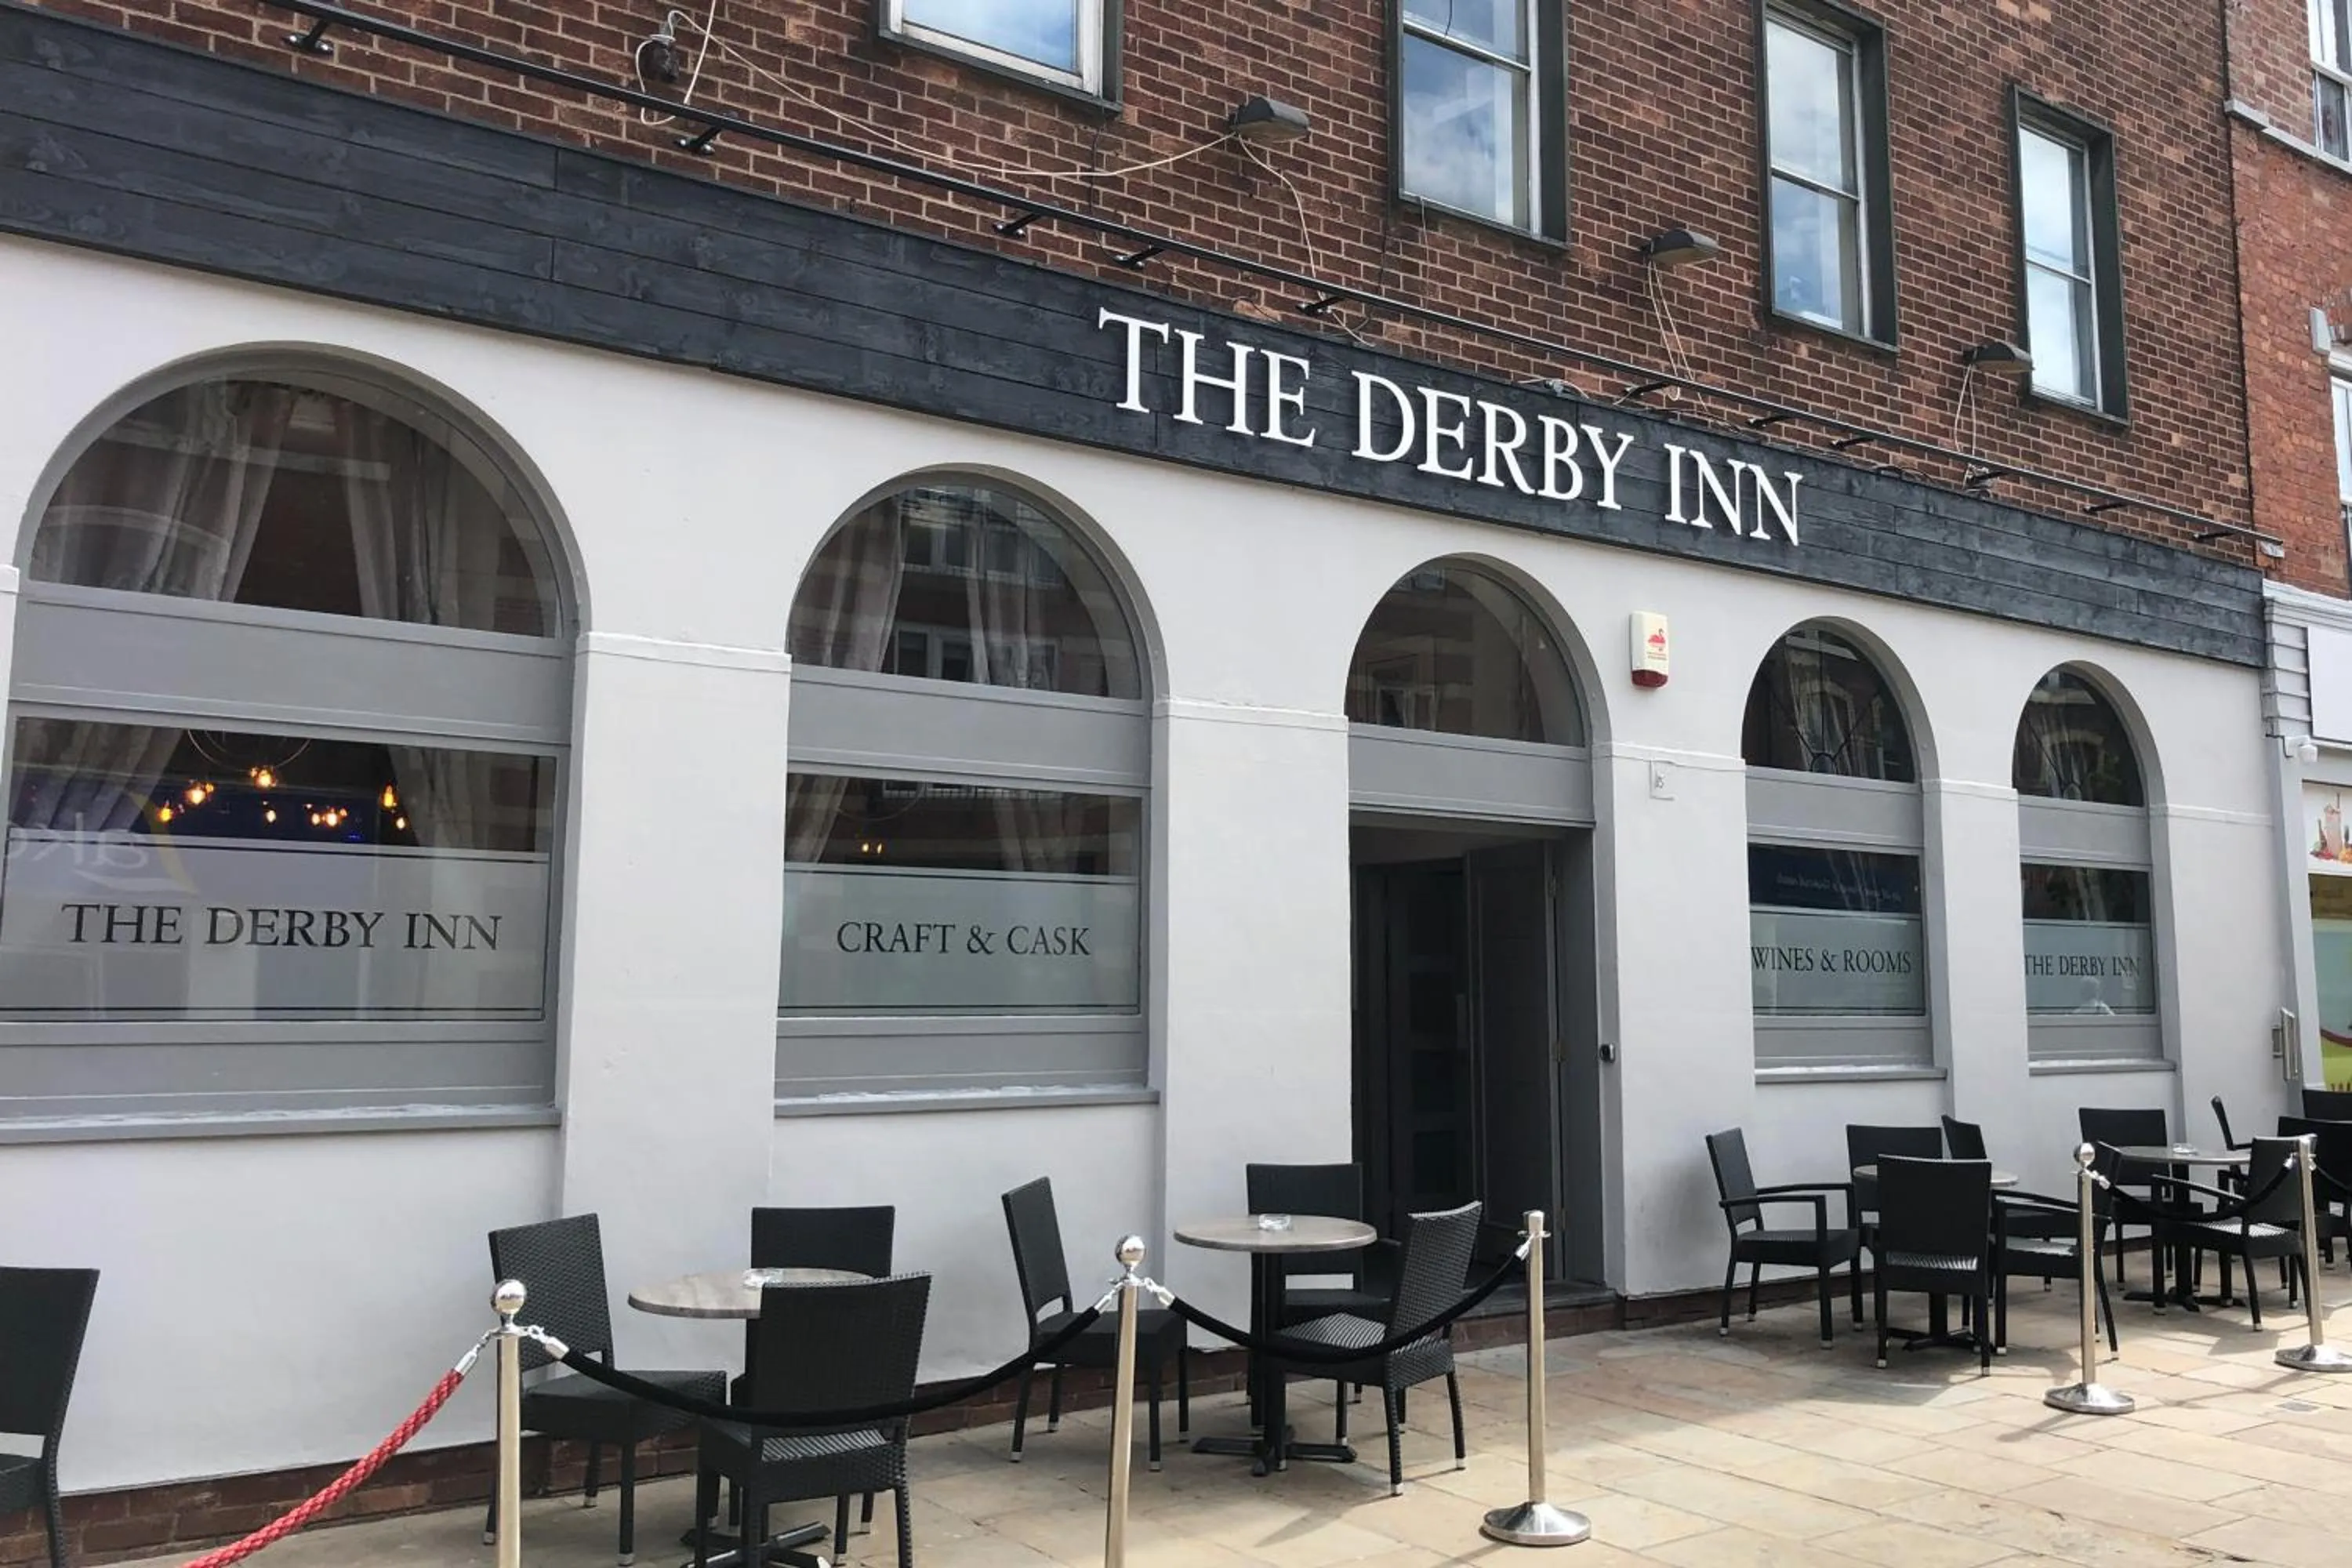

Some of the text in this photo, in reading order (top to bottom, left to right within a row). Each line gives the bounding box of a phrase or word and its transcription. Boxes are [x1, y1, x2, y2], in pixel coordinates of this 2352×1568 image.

[1098, 307, 1804, 547] THE DERBY INN
[62, 903, 502, 951] THE DERBY INN
[837, 921, 1091, 956] CRAFT & CASK
[1751, 946, 1911, 973] WINES & ROOMS
[2024, 955, 2141, 977] THE DERBY INN
